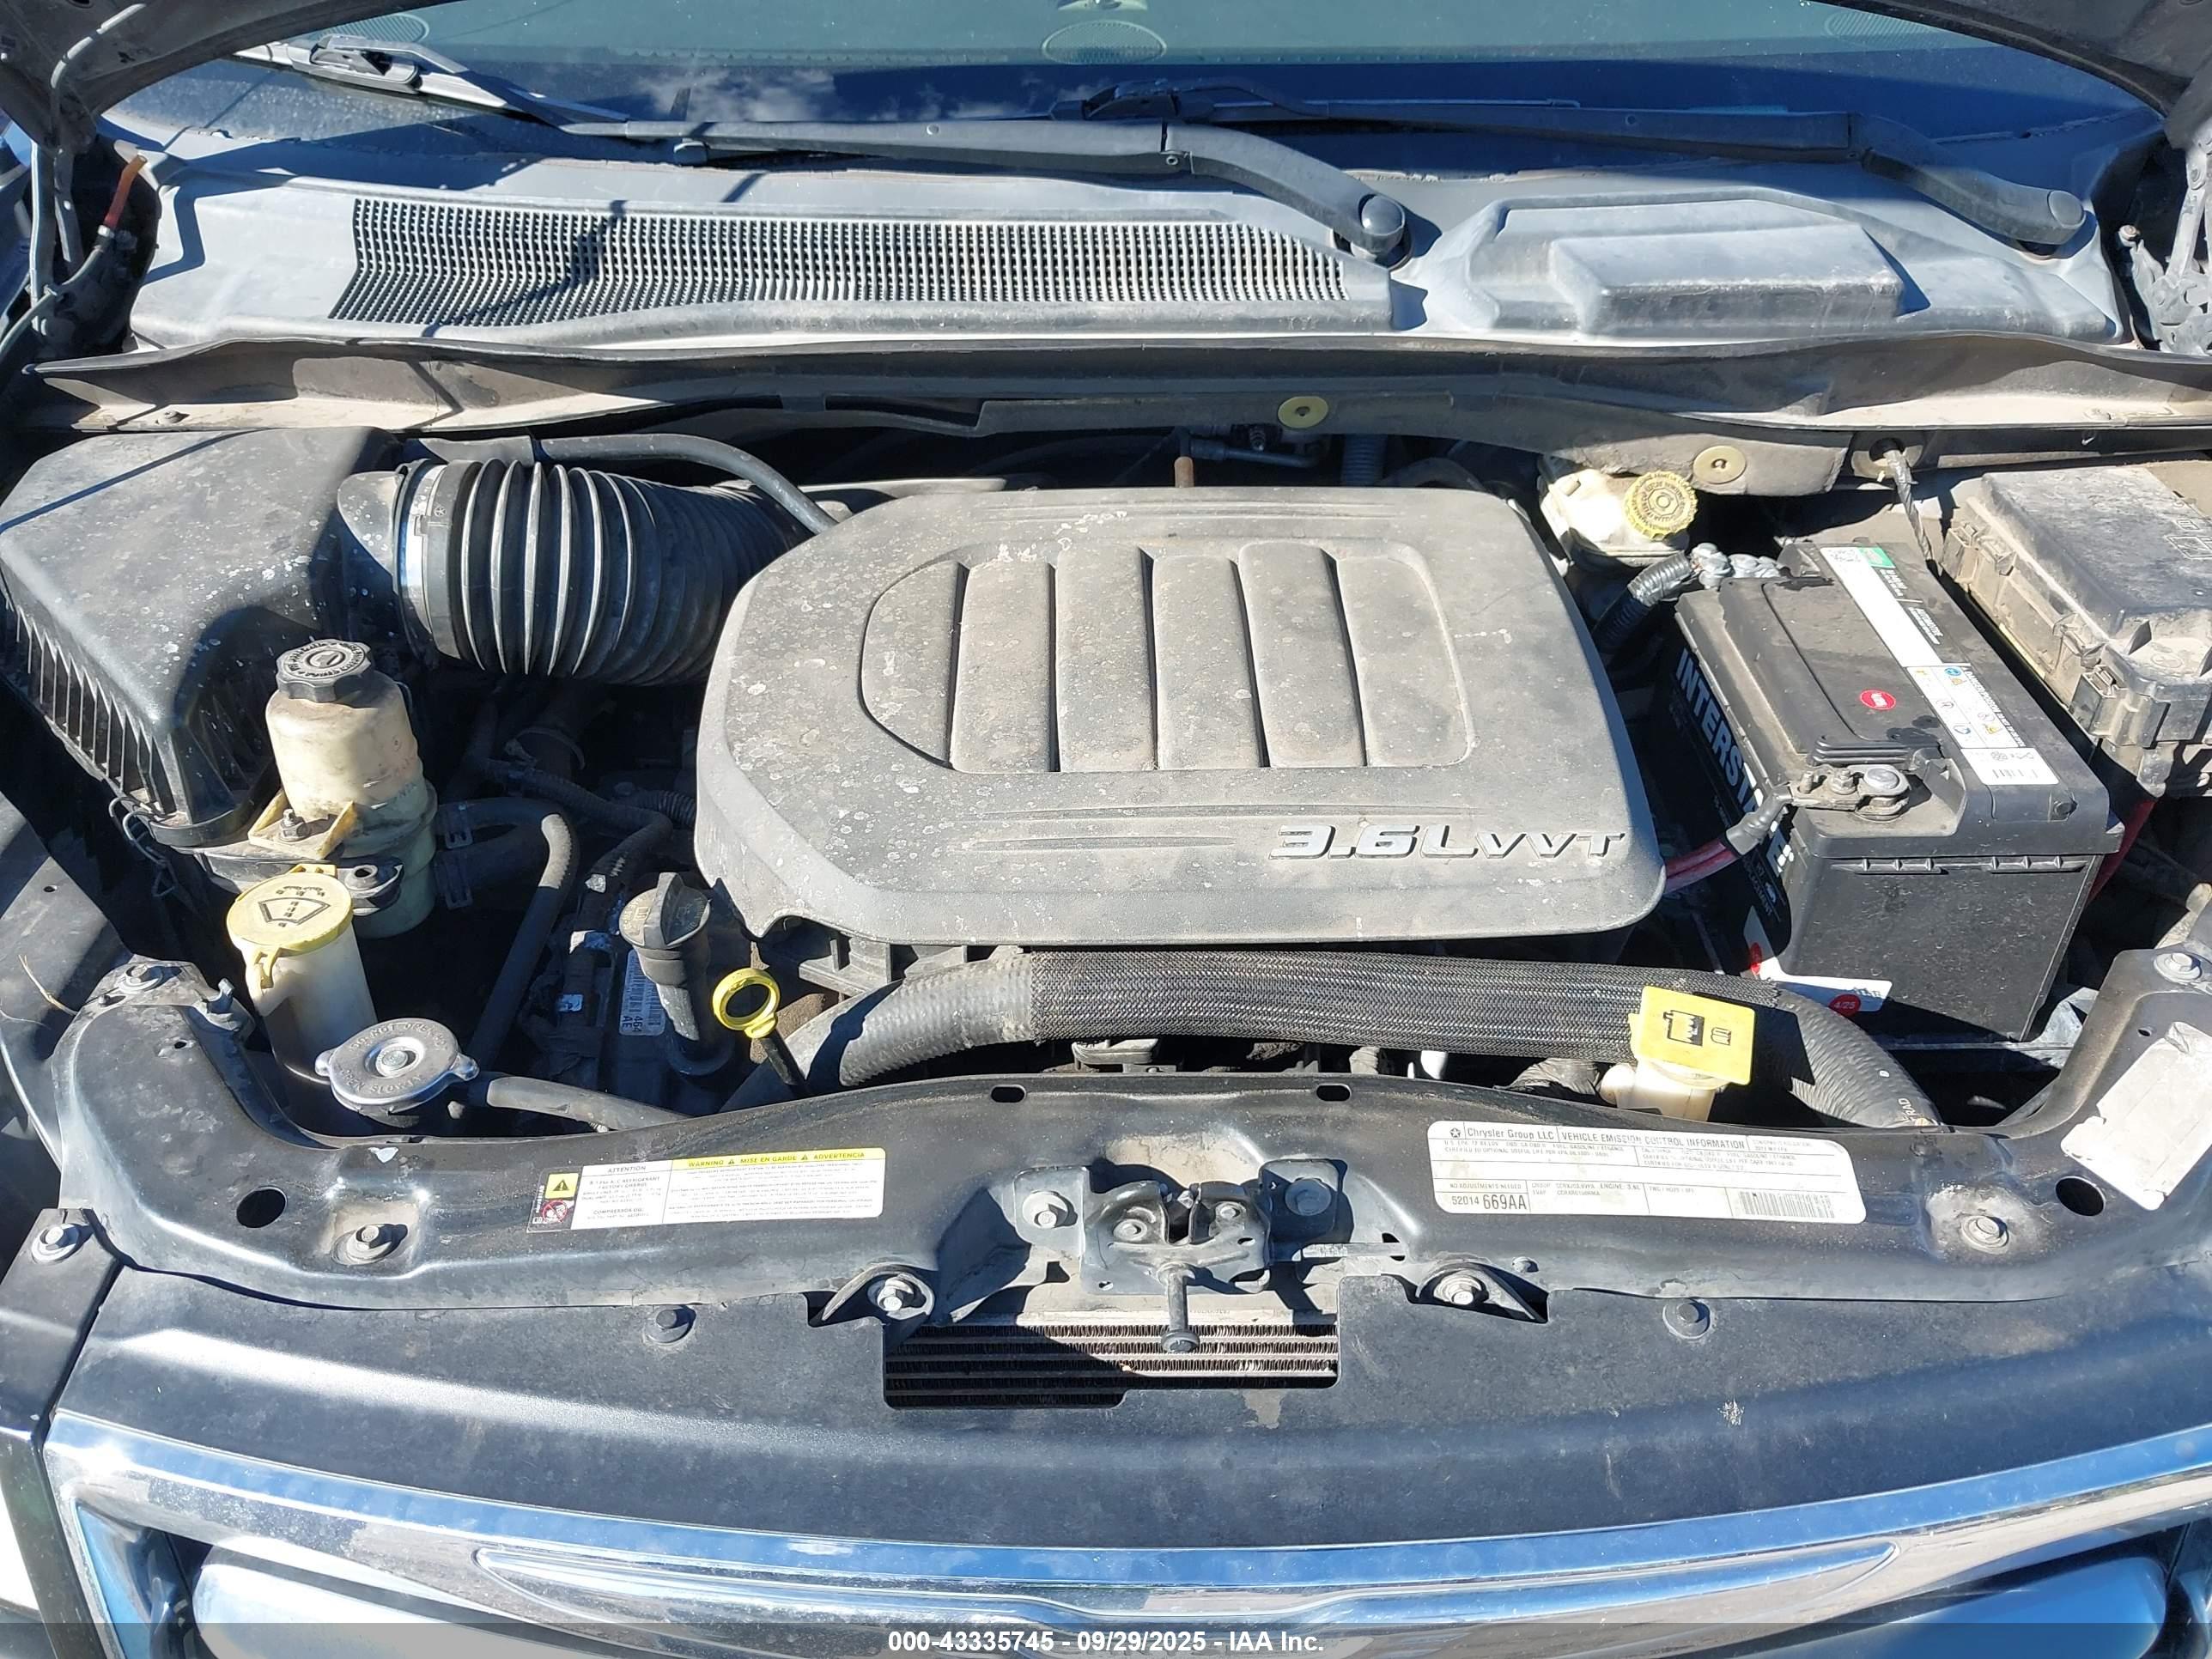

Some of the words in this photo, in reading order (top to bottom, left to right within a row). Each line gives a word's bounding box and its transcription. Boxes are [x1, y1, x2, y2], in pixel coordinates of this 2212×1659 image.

[1675, 648, 1792, 878] INTERSTAE
[1833, 1001, 1855, 1010] 4/25
[623, 1015, 633, 1028] AE
[1468, 1127, 1504, 1139] Chrysler
[1507, 1129, 1534, 1140] Group
[1538, 1131, 1554, 1140] LLC
[1561, 1132, 1599, 1142] VEHICLE
[1601, 1133, 1641, 1144] EMISSION
[1644, 1137, 1684, 1147] CONTROL
[1686, 1139, 1745, 1150] INFORMATION
[688, 1159, 725, 1168] WARNING
[813, 1152, 865, 1160] ADVERTENCIA
[1451, 1195, 1480, 1206] 52014
[1483, 1194, 1528, 1210] 669AA
